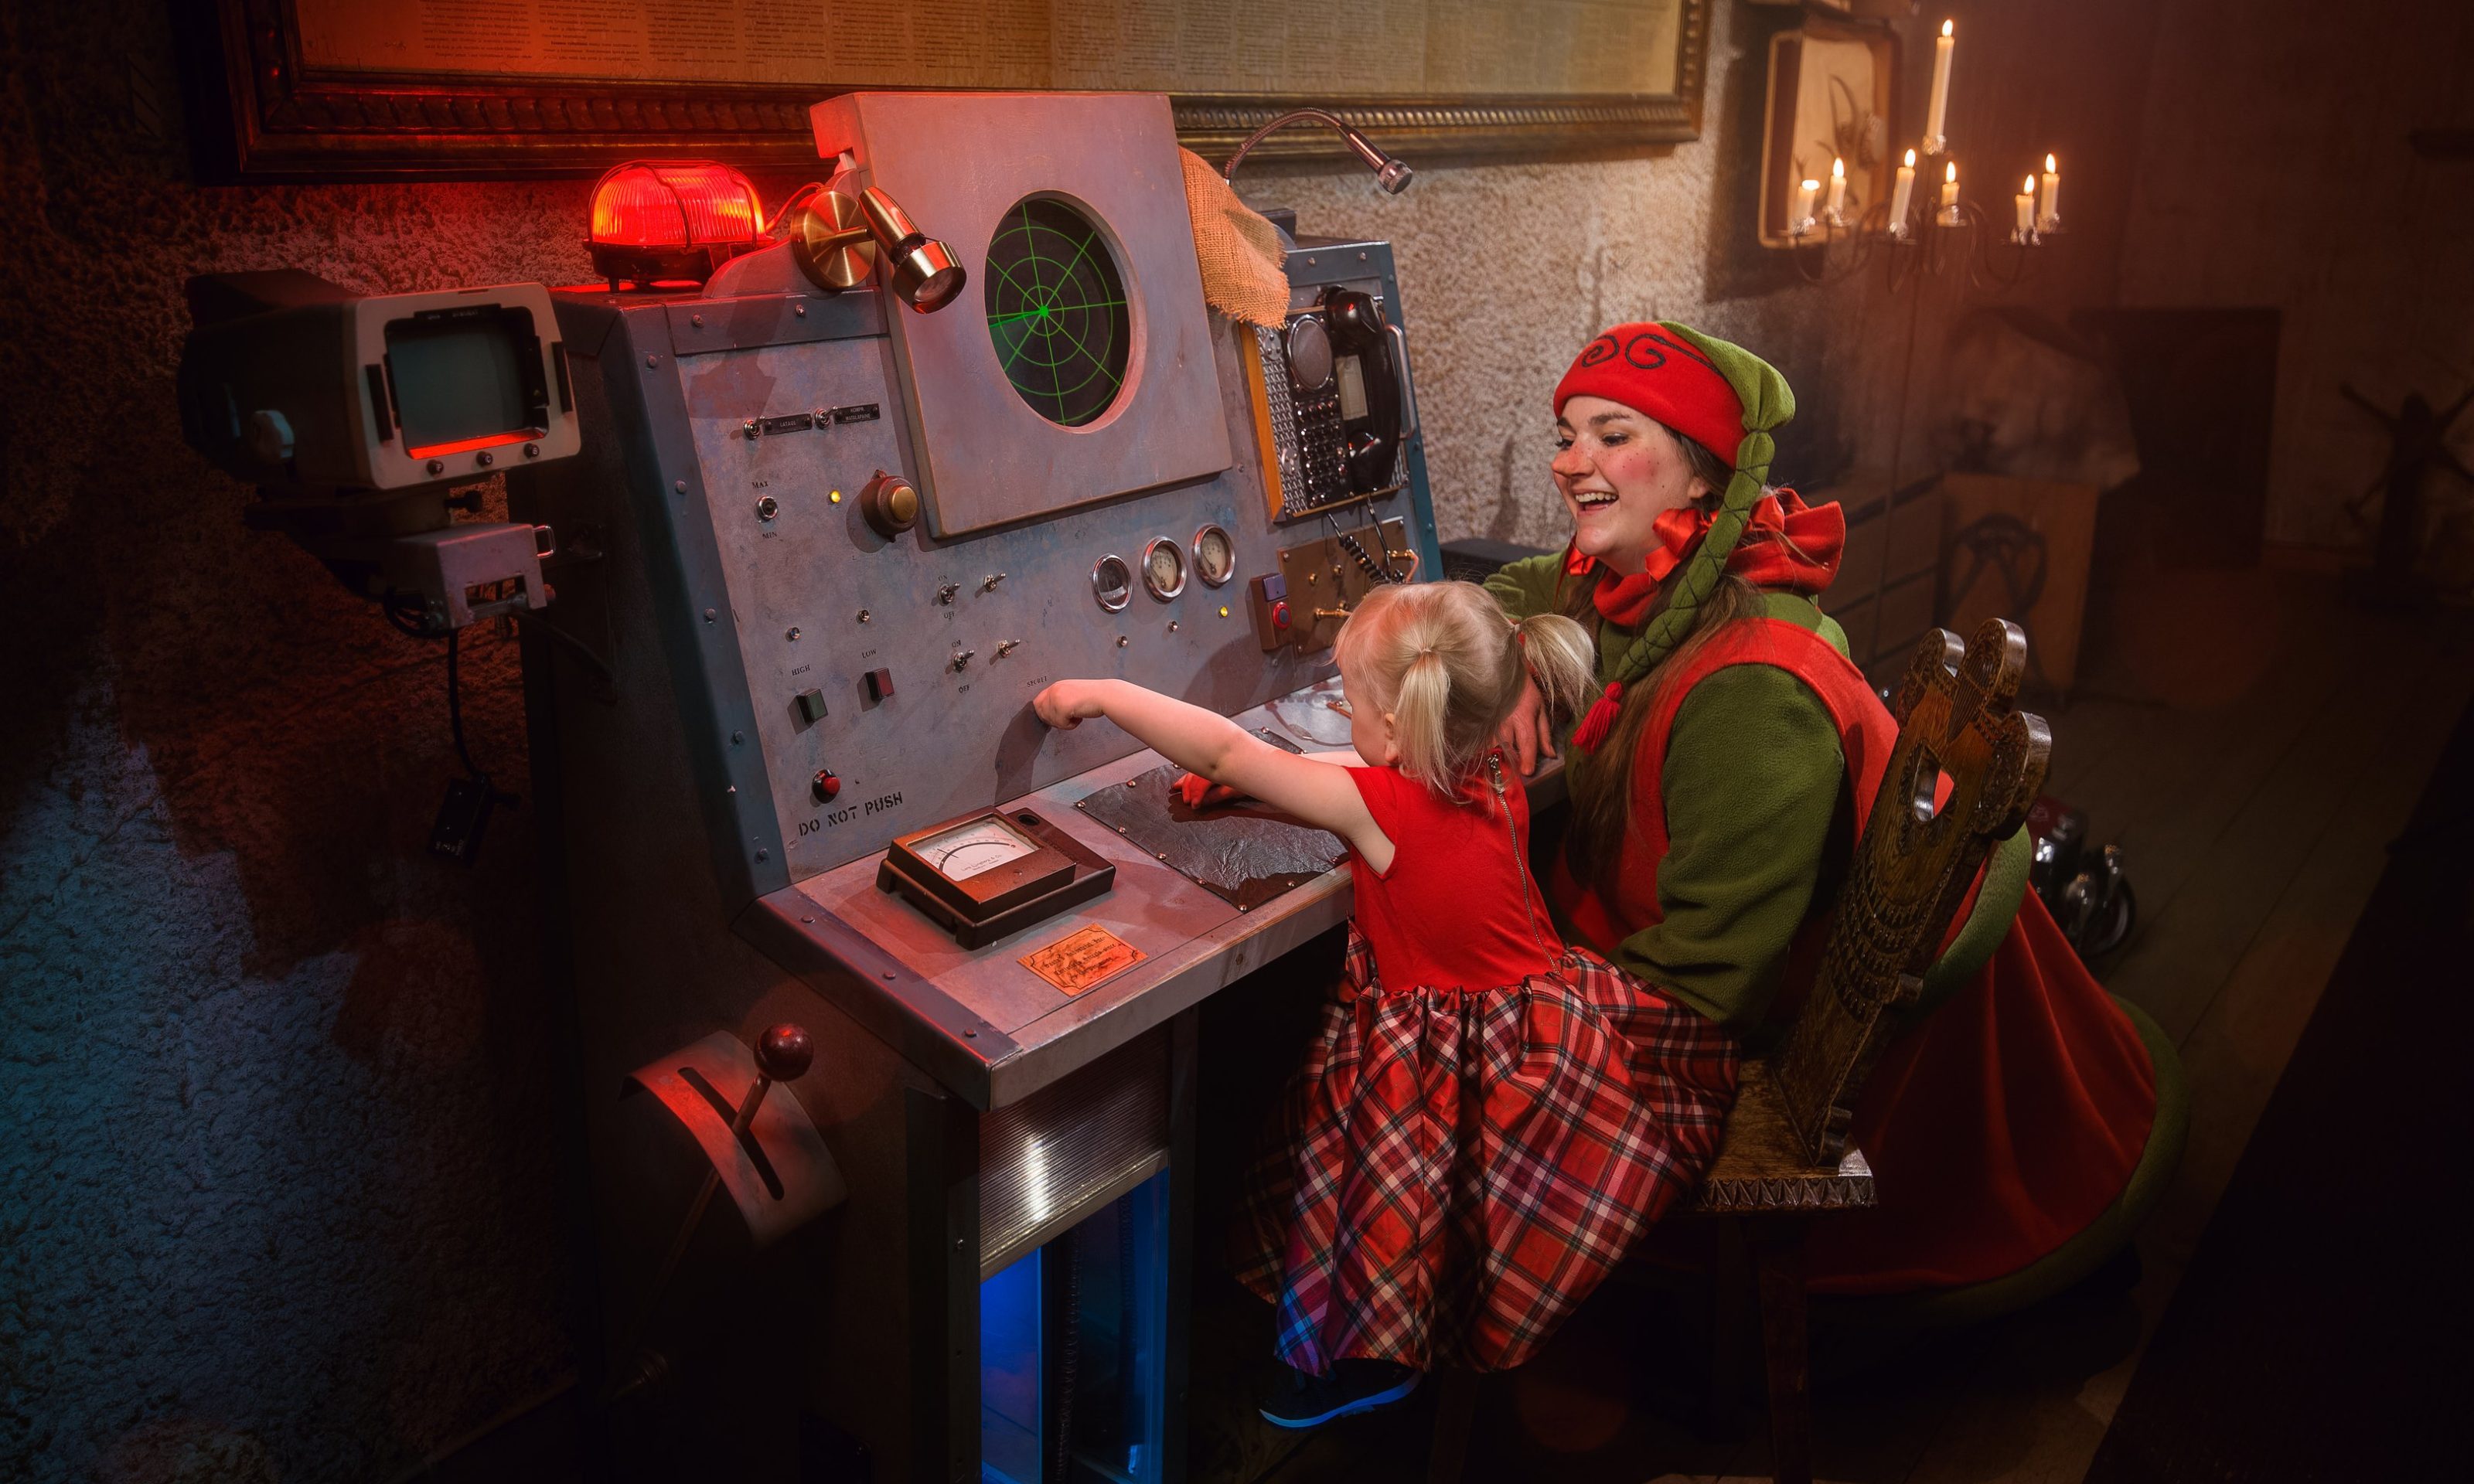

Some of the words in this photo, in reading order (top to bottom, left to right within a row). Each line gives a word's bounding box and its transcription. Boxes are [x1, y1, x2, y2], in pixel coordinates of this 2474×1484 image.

[951, 639, 962, 648] ON
[861, 649, 877, 659] LOW
[791, 664, 811, 676] HIGH
[959, 684, 970, 693] OFF
[799, 819, 820, 836] DO
[827, 805, 857, 827] NOT
[864, 791, 903, 815] PUSH
